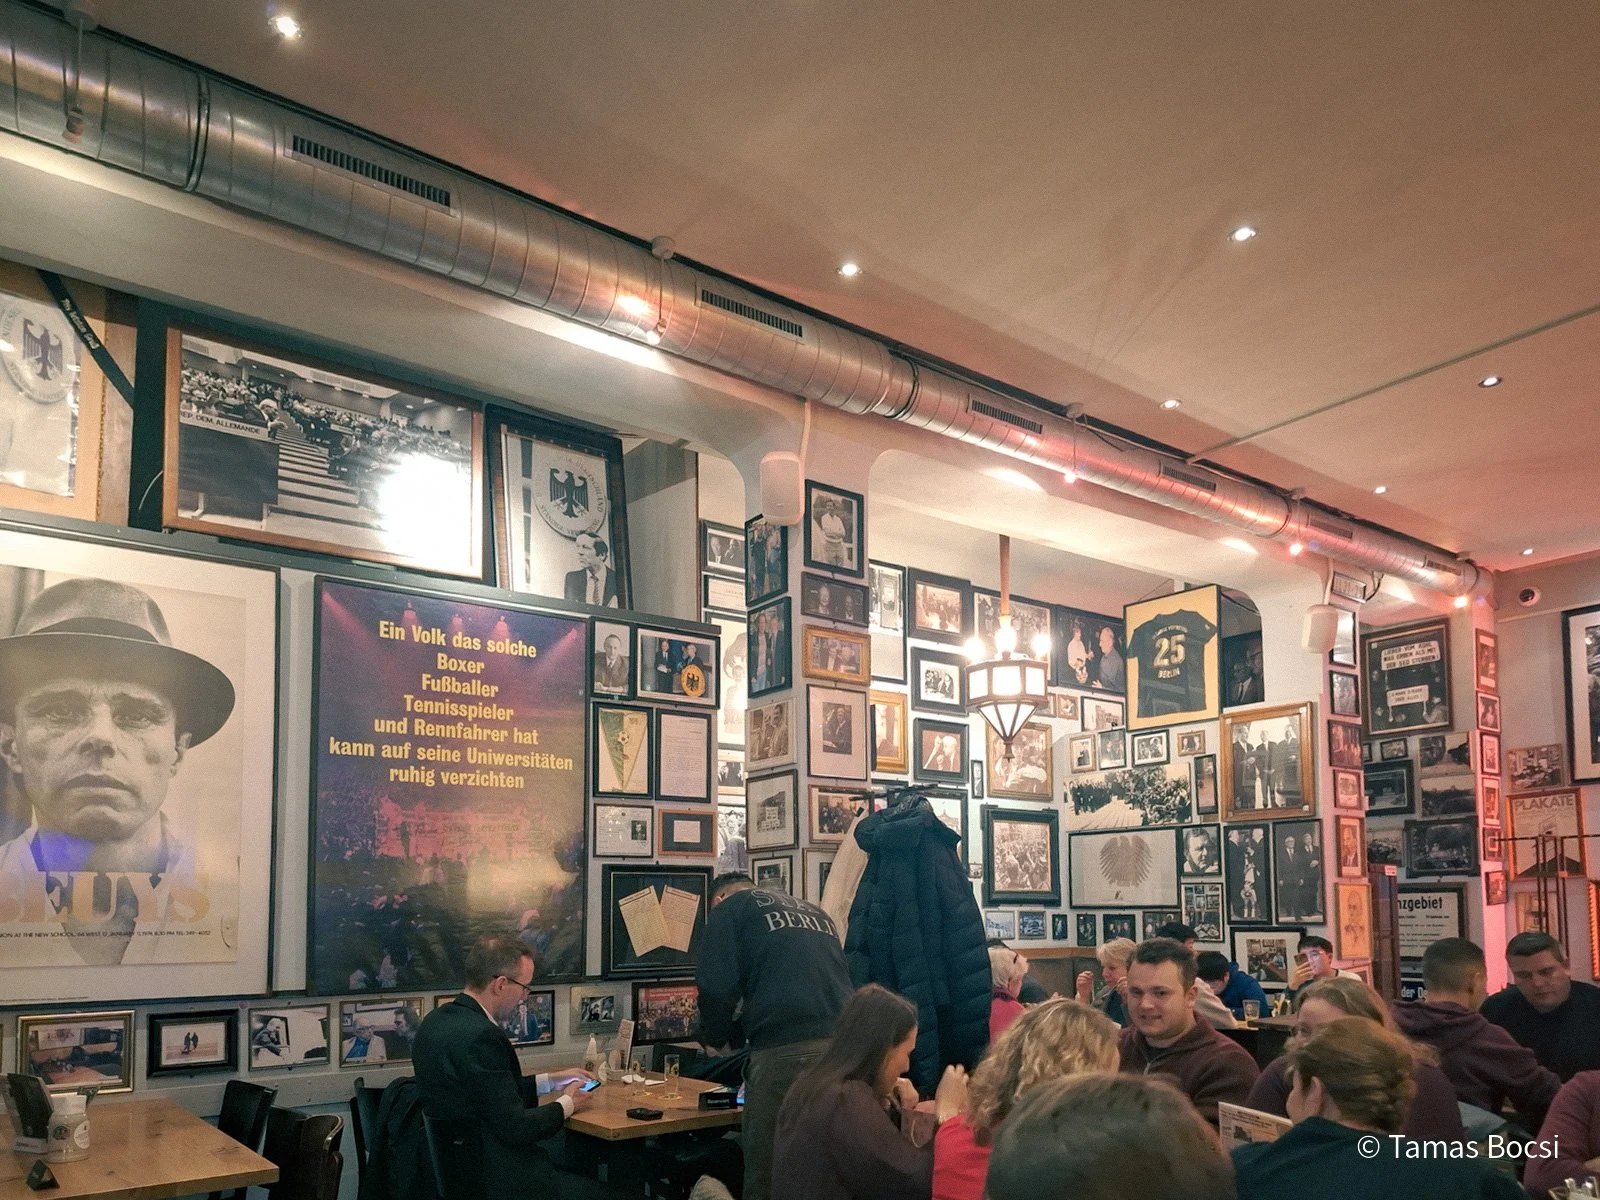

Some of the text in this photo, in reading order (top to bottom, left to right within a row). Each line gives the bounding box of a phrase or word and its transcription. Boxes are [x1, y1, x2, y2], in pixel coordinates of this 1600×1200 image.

[216, 419, 260, 434] ALLEMANDE
[379, 620, 537, 658] Ein Volk das solche
[1153, 633, 1186, 666] 25
[437, 653, 485, 674] Boxer
[422, 673, 499, 698] Fußballer
[404, 694, 514, 721] Tennisspieler
[374, 717, 539, 745] und Rennfahrer hat
[329, 737, 573, 771] kann auf seine Uniwersitäten
[389, 765, 525, 789] ruhig verzichten
[1514, 794, 1574, 811] PLAKATE
[1400, 986, 1416, 999] der
